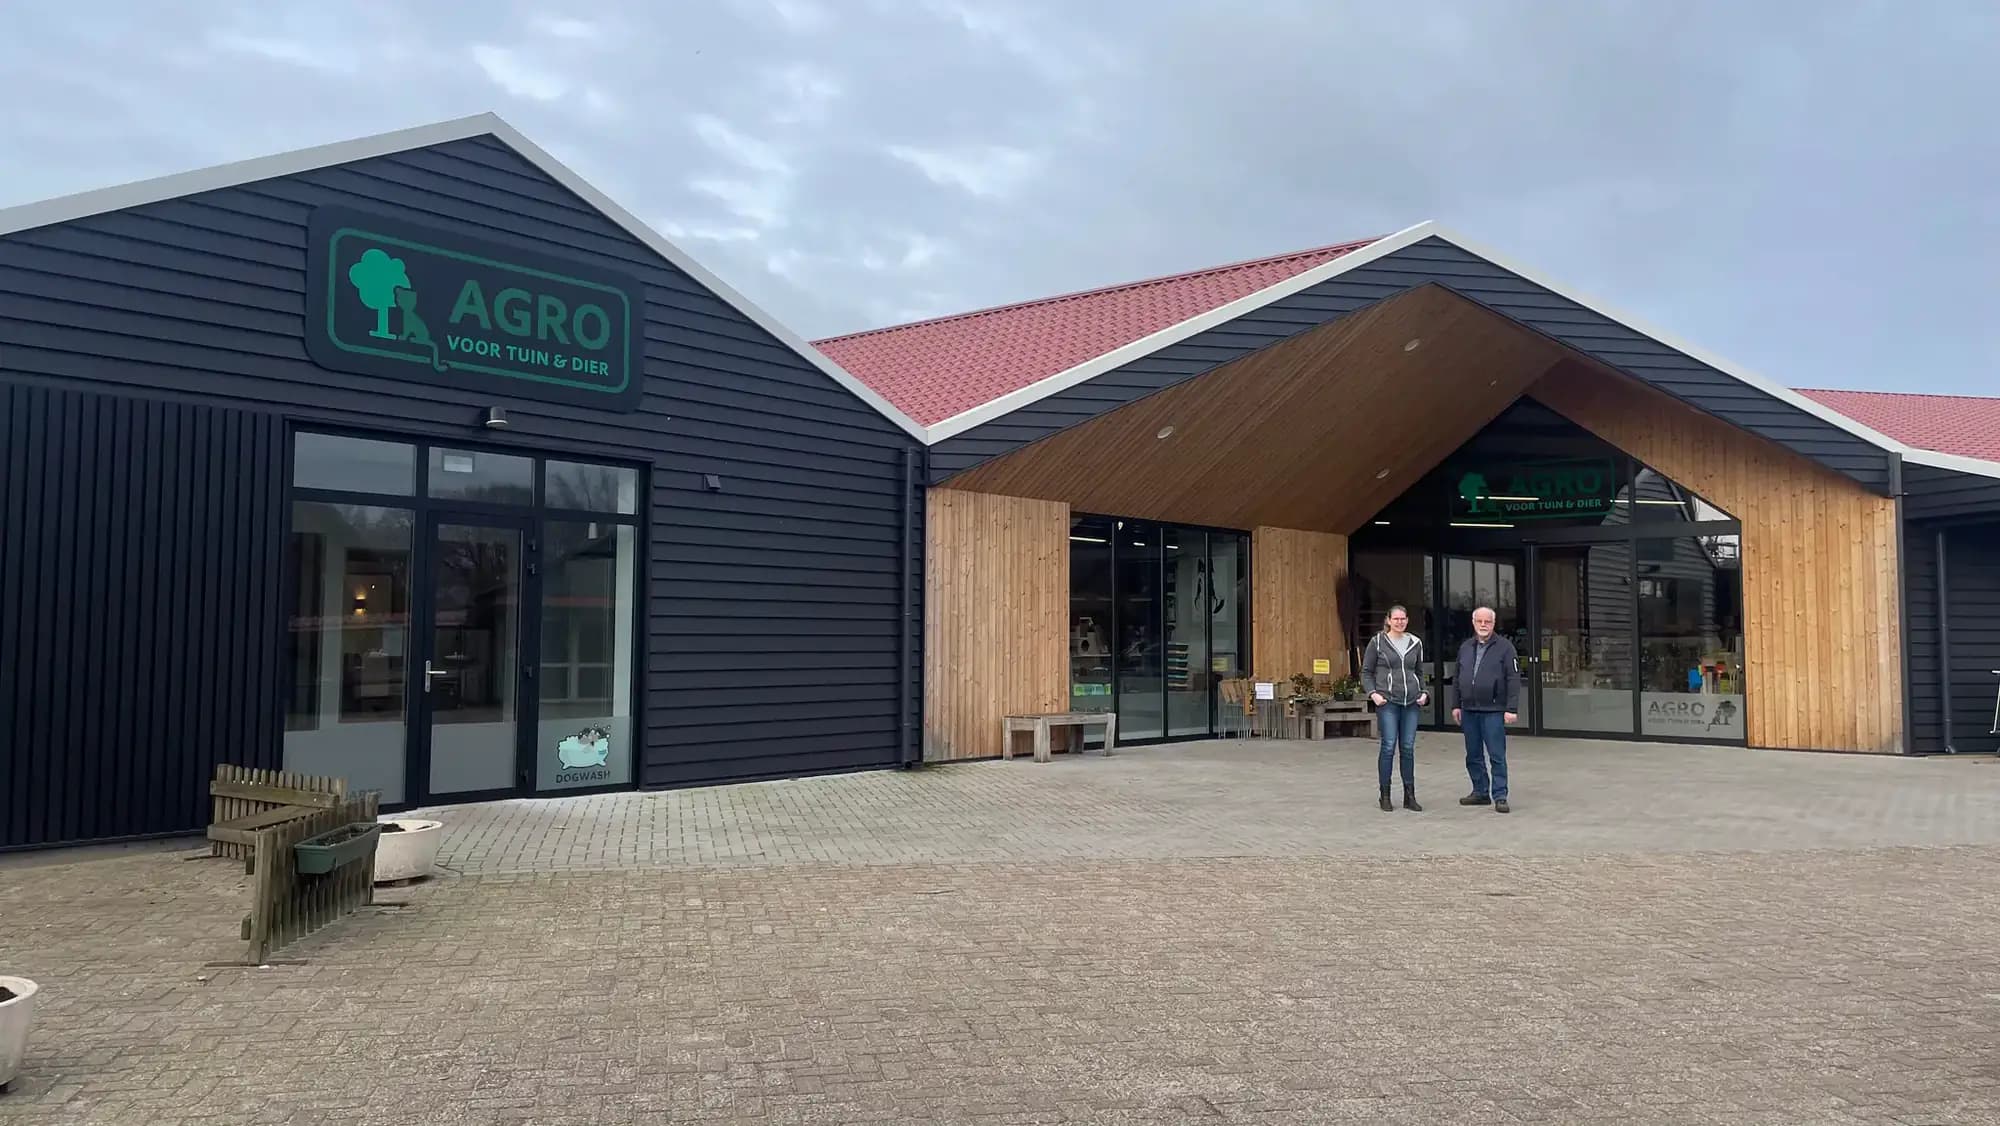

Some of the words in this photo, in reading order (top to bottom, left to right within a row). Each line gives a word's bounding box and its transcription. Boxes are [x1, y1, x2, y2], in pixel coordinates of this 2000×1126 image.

[449, 279, 611, 350] AGRO
[447, 335, 501, 358] VOOR
[506, 345, 549, 366] TUIN
[553, 354, 568, 368] &
[572, 356, 609, 376] DIER
[1508, 468, 1603, 496] AGRO
[1505, 502, 1536, 512] VOOR
[1538, 500, 1564, 510] TUIN
[1566, 499, 1575, 509] &
[1577, 498, 1602, 508] DIER
[1647, 701, 1705, 717] AGRO
[556, 770, 610, 784] DOGWASH
